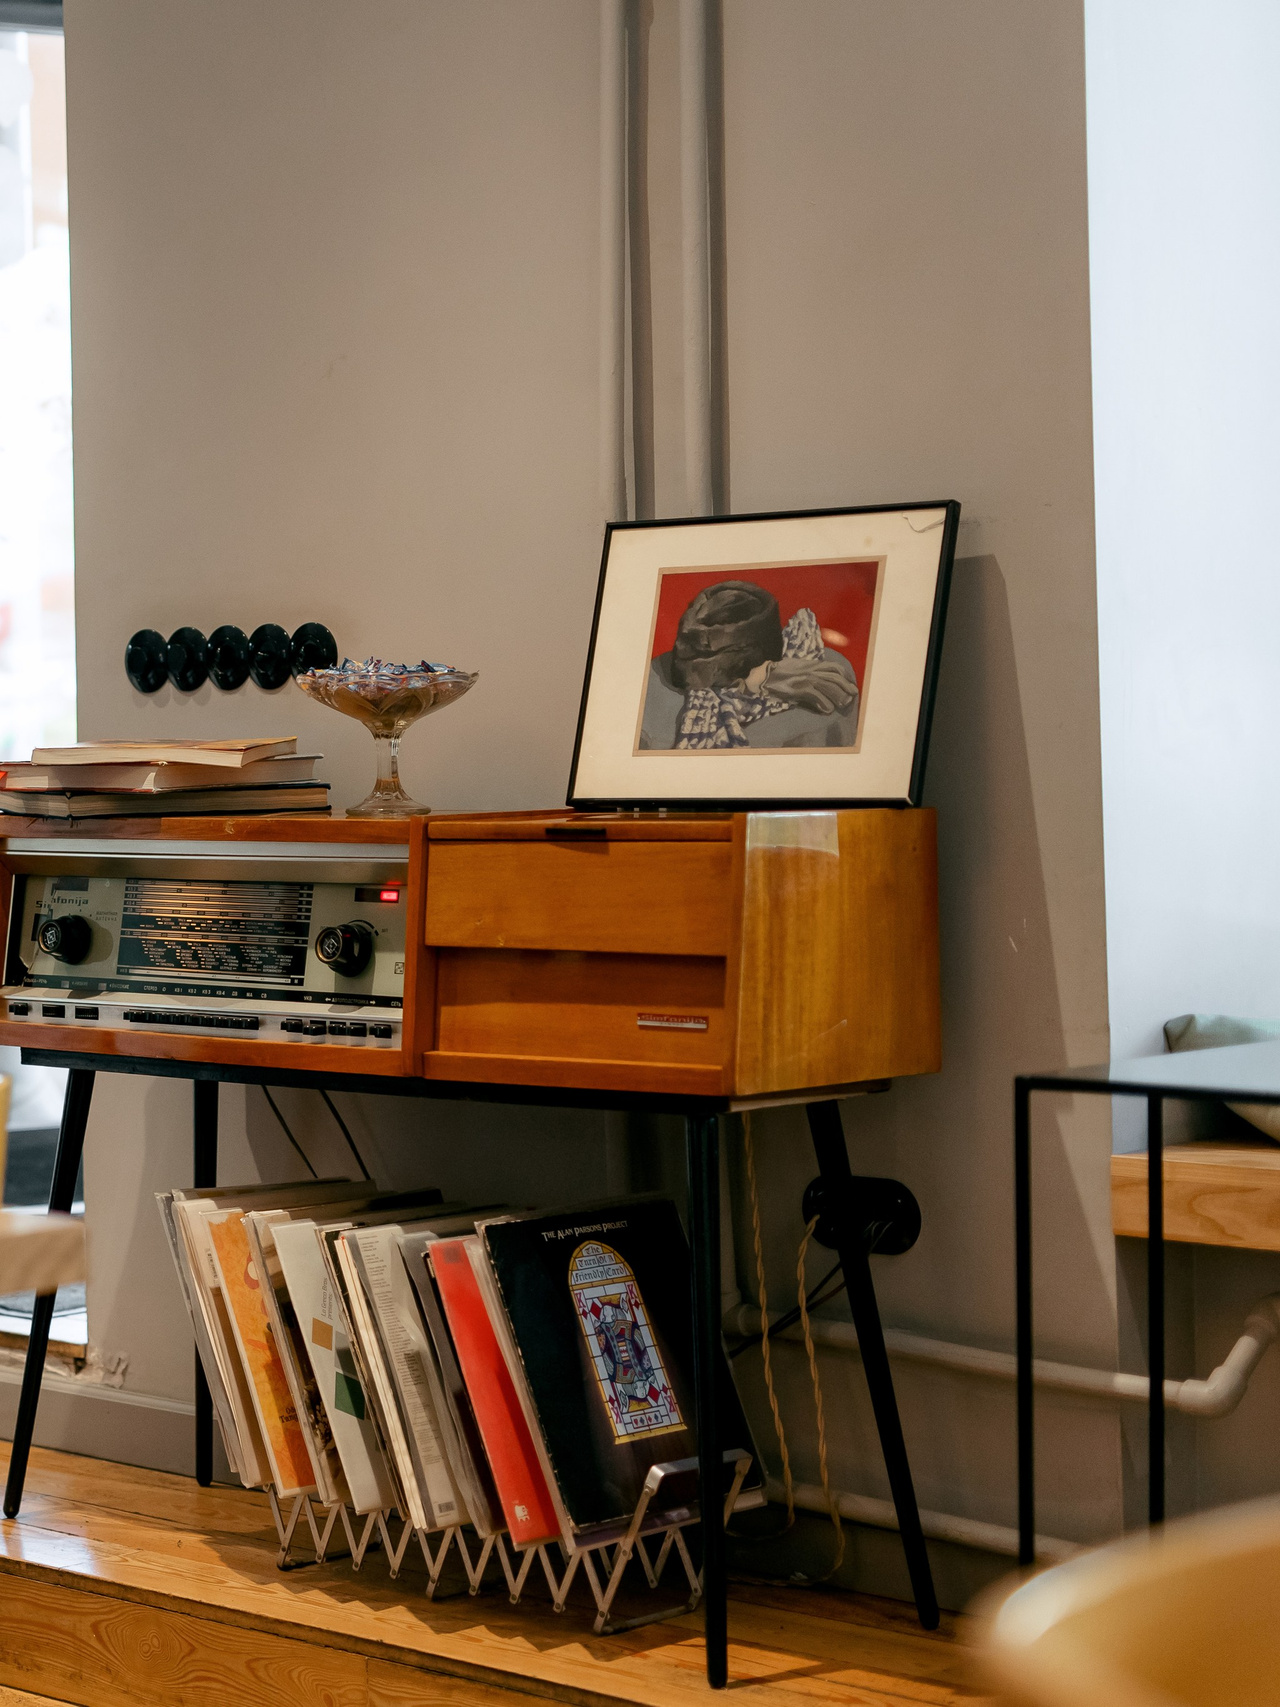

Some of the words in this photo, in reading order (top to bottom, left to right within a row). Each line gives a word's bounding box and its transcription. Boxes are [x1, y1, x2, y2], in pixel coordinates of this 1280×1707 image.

[541, 1230, 557, 1242] THE
[557, 1228, 574, 1240] ALAN
[574, 1223, 602, 1237] PARSONS
[602, 1220, 628, 1233] PROJECT
[584, 1245, 601, 1255] The
[578, 1257, 598, 1269] Turn
[575, 1269, 605, 1283] Friendly
[605, 1266, 626, 1278] Card
[627, 1284, 639, 1300] K
[574, 1292, 586, 1309] K
